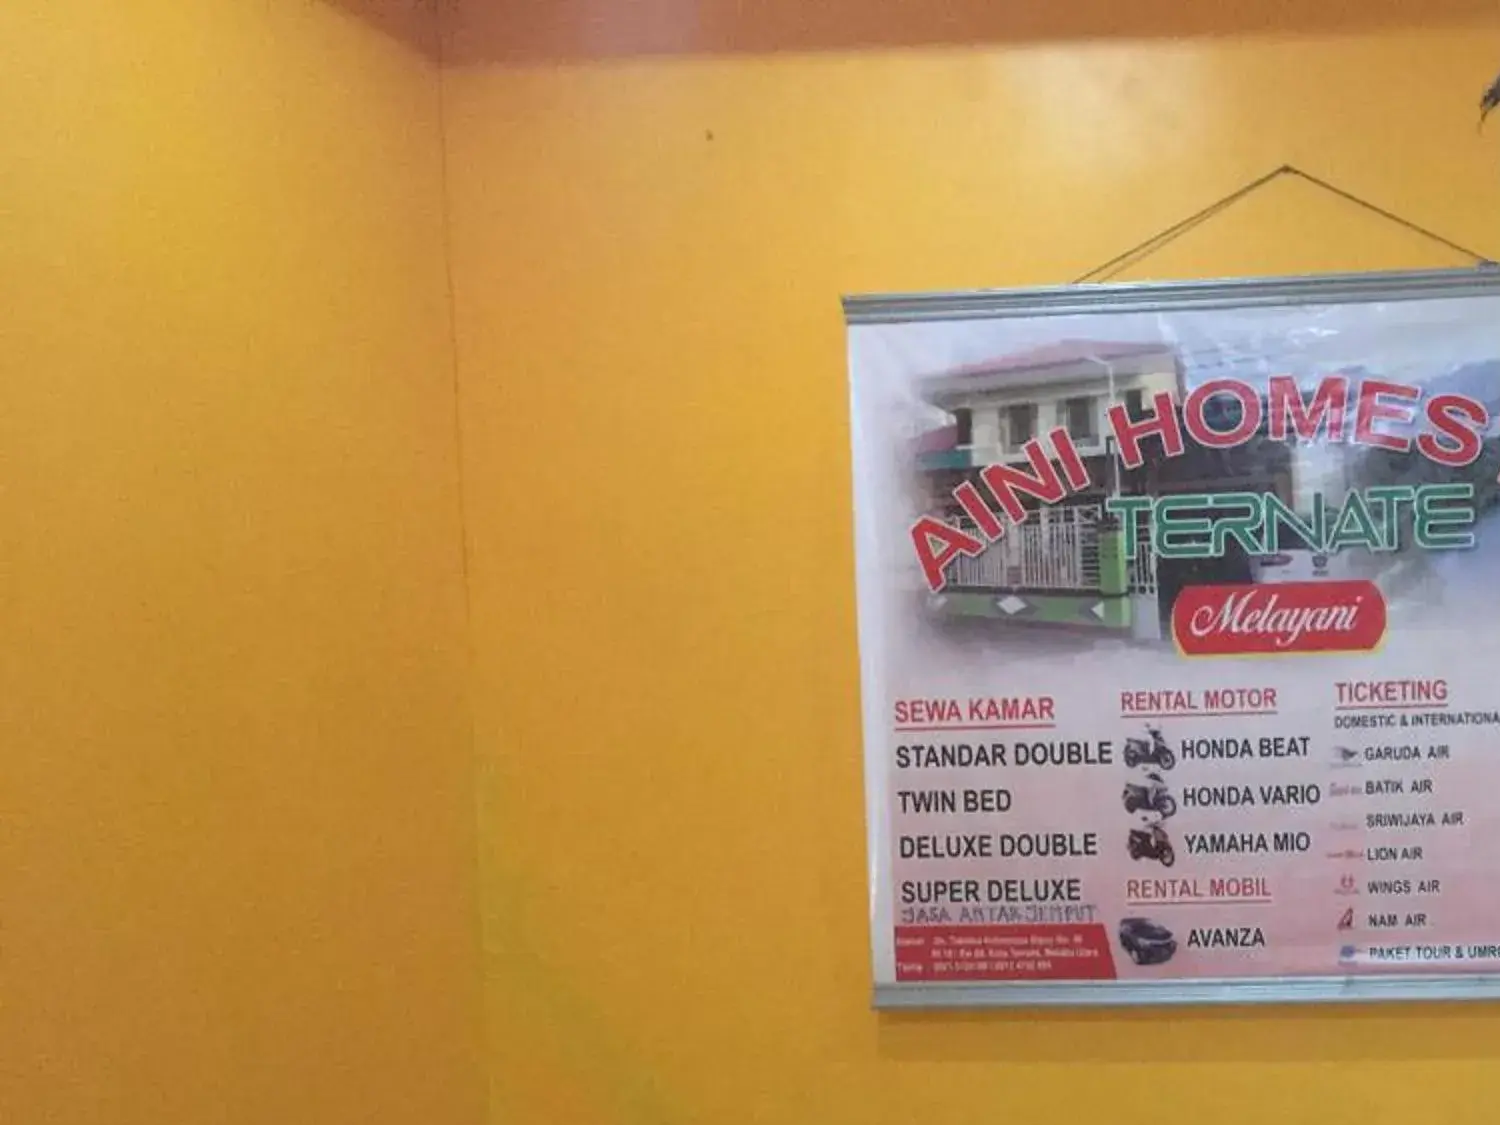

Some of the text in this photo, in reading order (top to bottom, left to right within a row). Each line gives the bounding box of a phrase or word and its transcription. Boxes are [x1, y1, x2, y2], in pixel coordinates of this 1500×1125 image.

[909, 426, 1091, 592] AINI
[1106, 483, 1475, 559] TERNATE
[1190, 589, 1363, 647] Melayani
[1120, 688, 1278, 711] RENTAL MOTOR
[1335, 679, 1448, 703] TICKETING
[894, 697, 1056, 723] SEWA KAMAR
[1334, 714, 1396, 729] DOMESTIC
[1401, 713, 1409, 727] &
[896, 741, 1114, 768] STANDAR DOUBLE
[1181, 737, 1311, 759] HONDA BEAT
[1364, 745, 1451, 761] GARUDA AIR
[1183, 786, 1255, 806] HONDA
[1260, 784, 1321, 805] VARIO
[1365, 780, 1404, 795] BATIK
[1411, 779, 1433, 793] AIR
[897, 789, 1012, 814] TWIN BED
[1366, 813, 1435, 828] SRIWIJAYA
[1441, 811, 1465, 826] AIR
[900, 833, 1098, 859] DELUXE DOUBLE
[1184, 832, 1311, 854] YAMAHA MIO
[1367, 847, 1397, 861] LION
[1401, 847, 1423, 860] AIR
[901, 879, 1081, 903] SUPER DELUXE
[1127, 877, 1272, 899] RENTAL MOBIL
[1367, 881, 1411, 894] WINGS
[1418, 879, 1440, 893] AIR
[1368, 913, 1428, 928] NAM AIR
[1187, 928, 1266, 948] AVANZA
[1369, 947, 1410, 960] PAKET
[1417, 946, 1450, 959] TOUR
[1455, 945, 1464, 959] &
